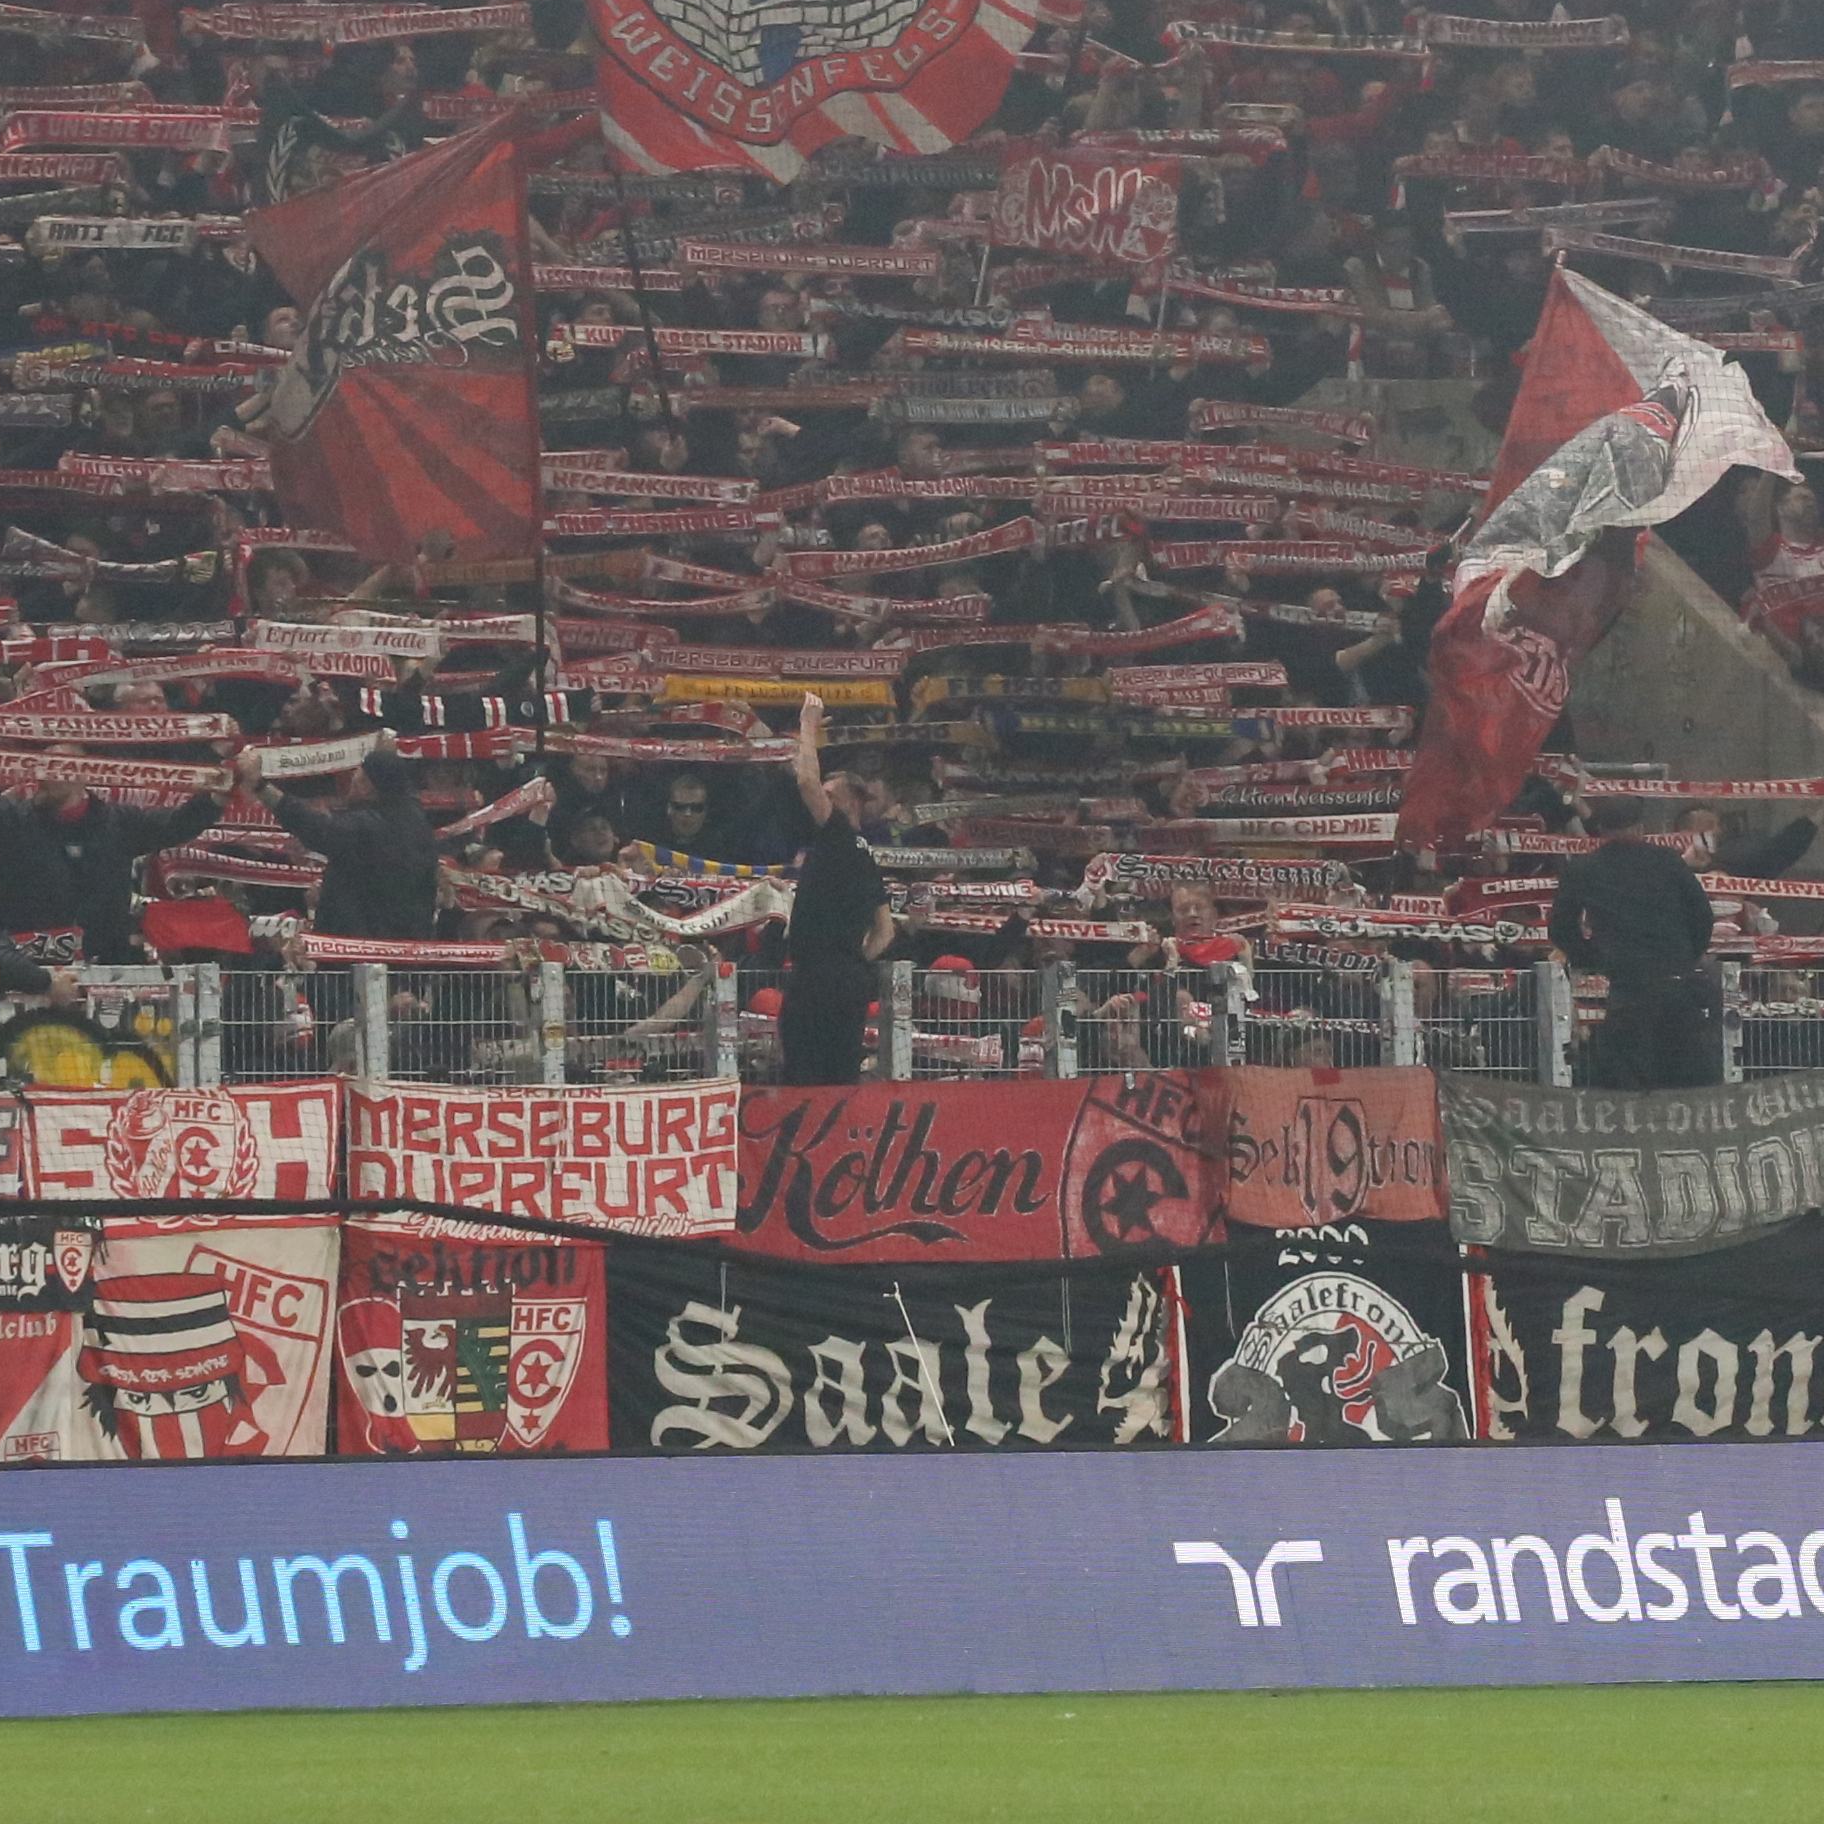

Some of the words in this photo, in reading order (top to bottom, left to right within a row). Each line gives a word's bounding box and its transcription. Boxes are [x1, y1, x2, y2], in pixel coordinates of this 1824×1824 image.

[48, 222, 104, 243] ANTI
[265, 624, 335, 648] Erfurt
[371, 628, 430, 652] Halle
[1238, 818, 1287, 837] HFC
[1292, 816, 1381, 837] CHEMIE
[174, 1101, 223, 1122] HFC
[350, 1091, 737, 1158] MERSEBURG
[349, 1150, 737, 1222] QUERFURT
[738, 1096, 1049, 1249] Köthen
[60, 1232, 85, 1245] HFC
[210, 1259, 306, 1330] HFC
[513, 1306, 570, 1332] HFC
[650, 1296, 1077, 1449] Saale
[14, 1436, 50, 1452] HFC
